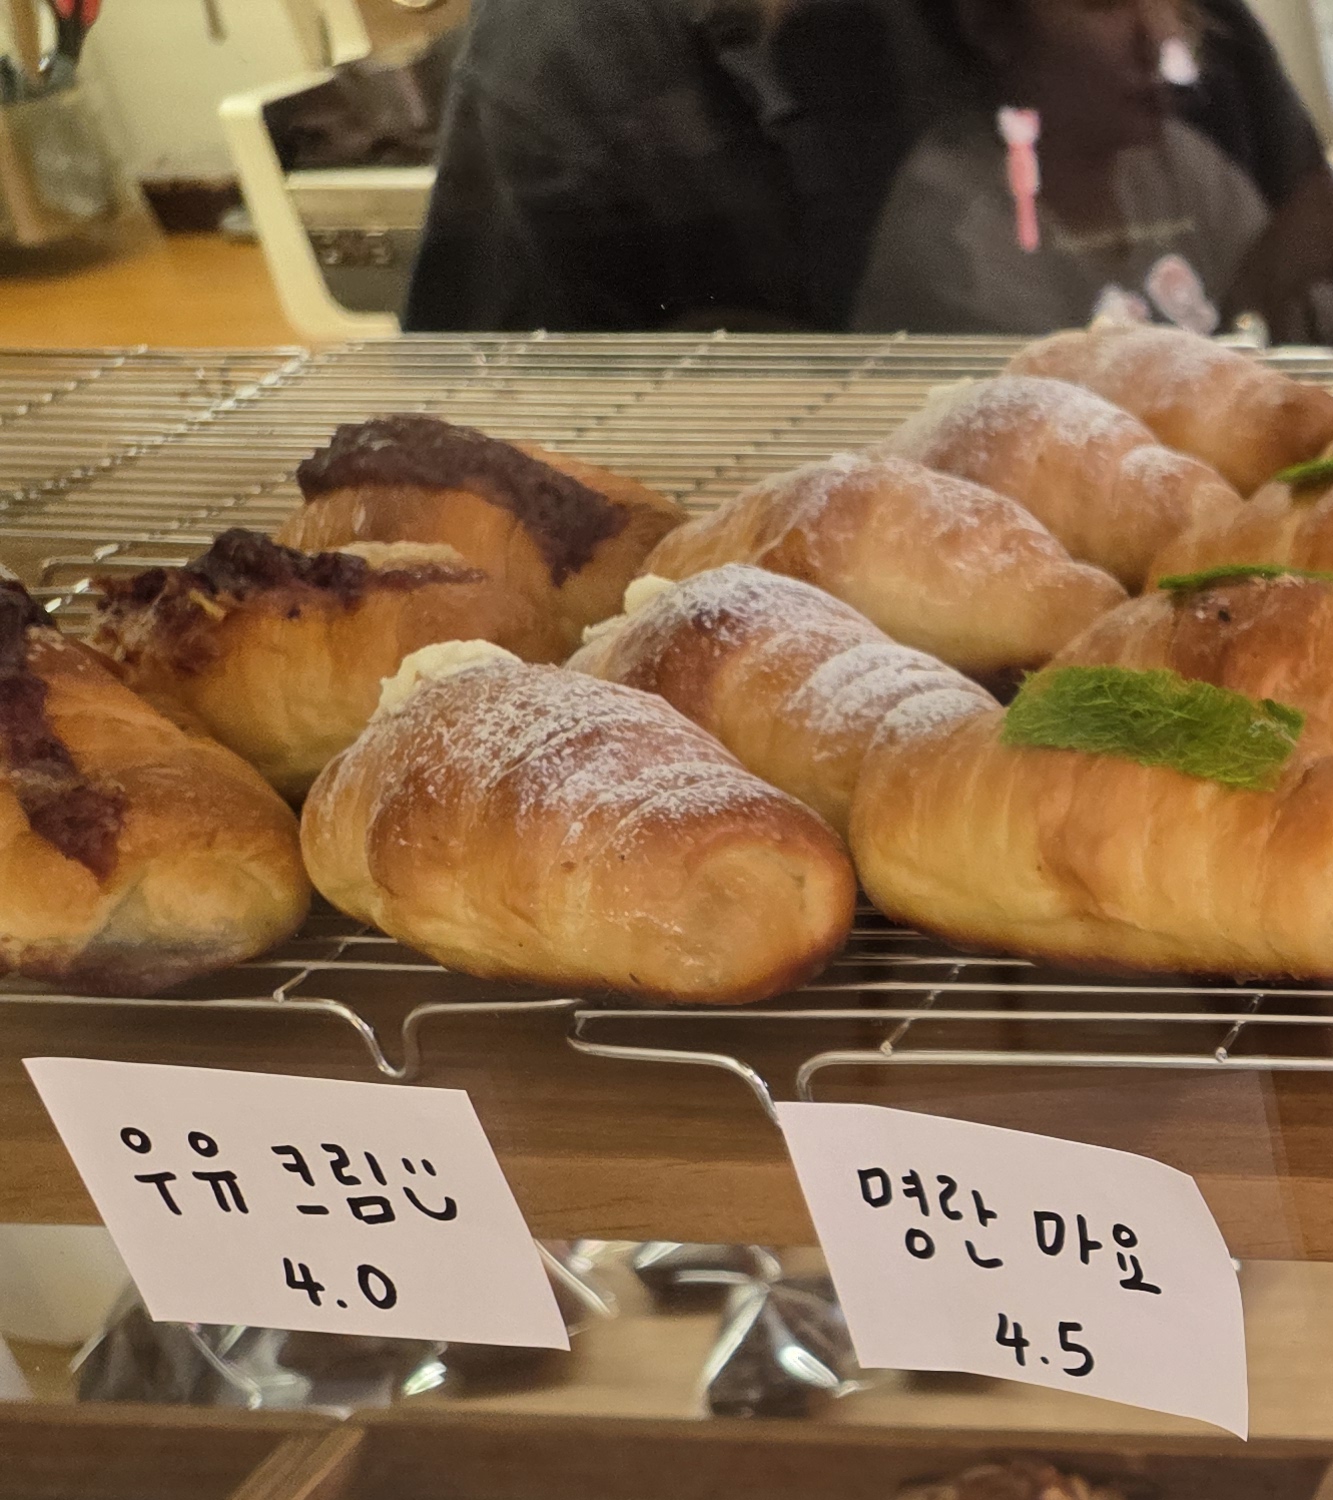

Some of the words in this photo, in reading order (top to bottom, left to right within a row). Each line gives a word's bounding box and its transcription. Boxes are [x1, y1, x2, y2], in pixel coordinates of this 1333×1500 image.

[119, 1126, 250, 1217] 우유
[269, 1142, 397, 1226] 크림
[856, 1166, 1004, 1270] 명란
[1032, 1209, 1163, 1296] 마요
[281, 1256, 398, 1311] 4.0
[991, 1311, 1095, 1377] 4.5
